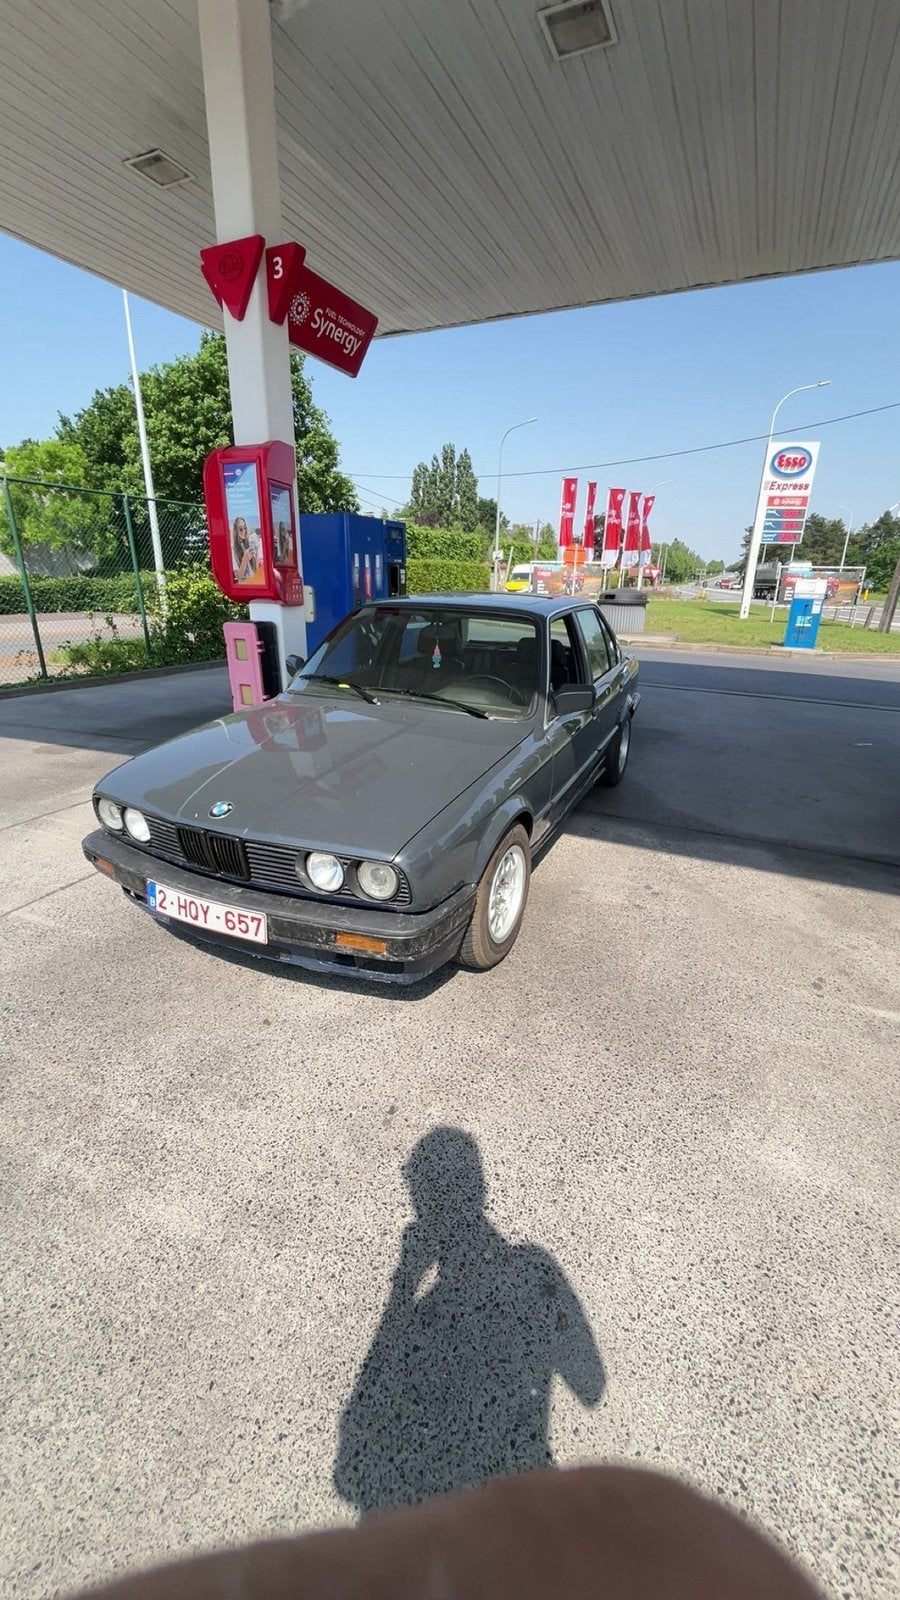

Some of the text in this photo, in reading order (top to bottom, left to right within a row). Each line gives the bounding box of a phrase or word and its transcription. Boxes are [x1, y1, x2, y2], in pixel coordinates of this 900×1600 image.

[273, 256, 284, 279] 3
[310, 308, 362, 357] Synergy
[325, 307, 365, 337] FUEL TECHNOLOGY
[777, 454, 807, 469] Esso
[769, 481, 810, 492] Express
